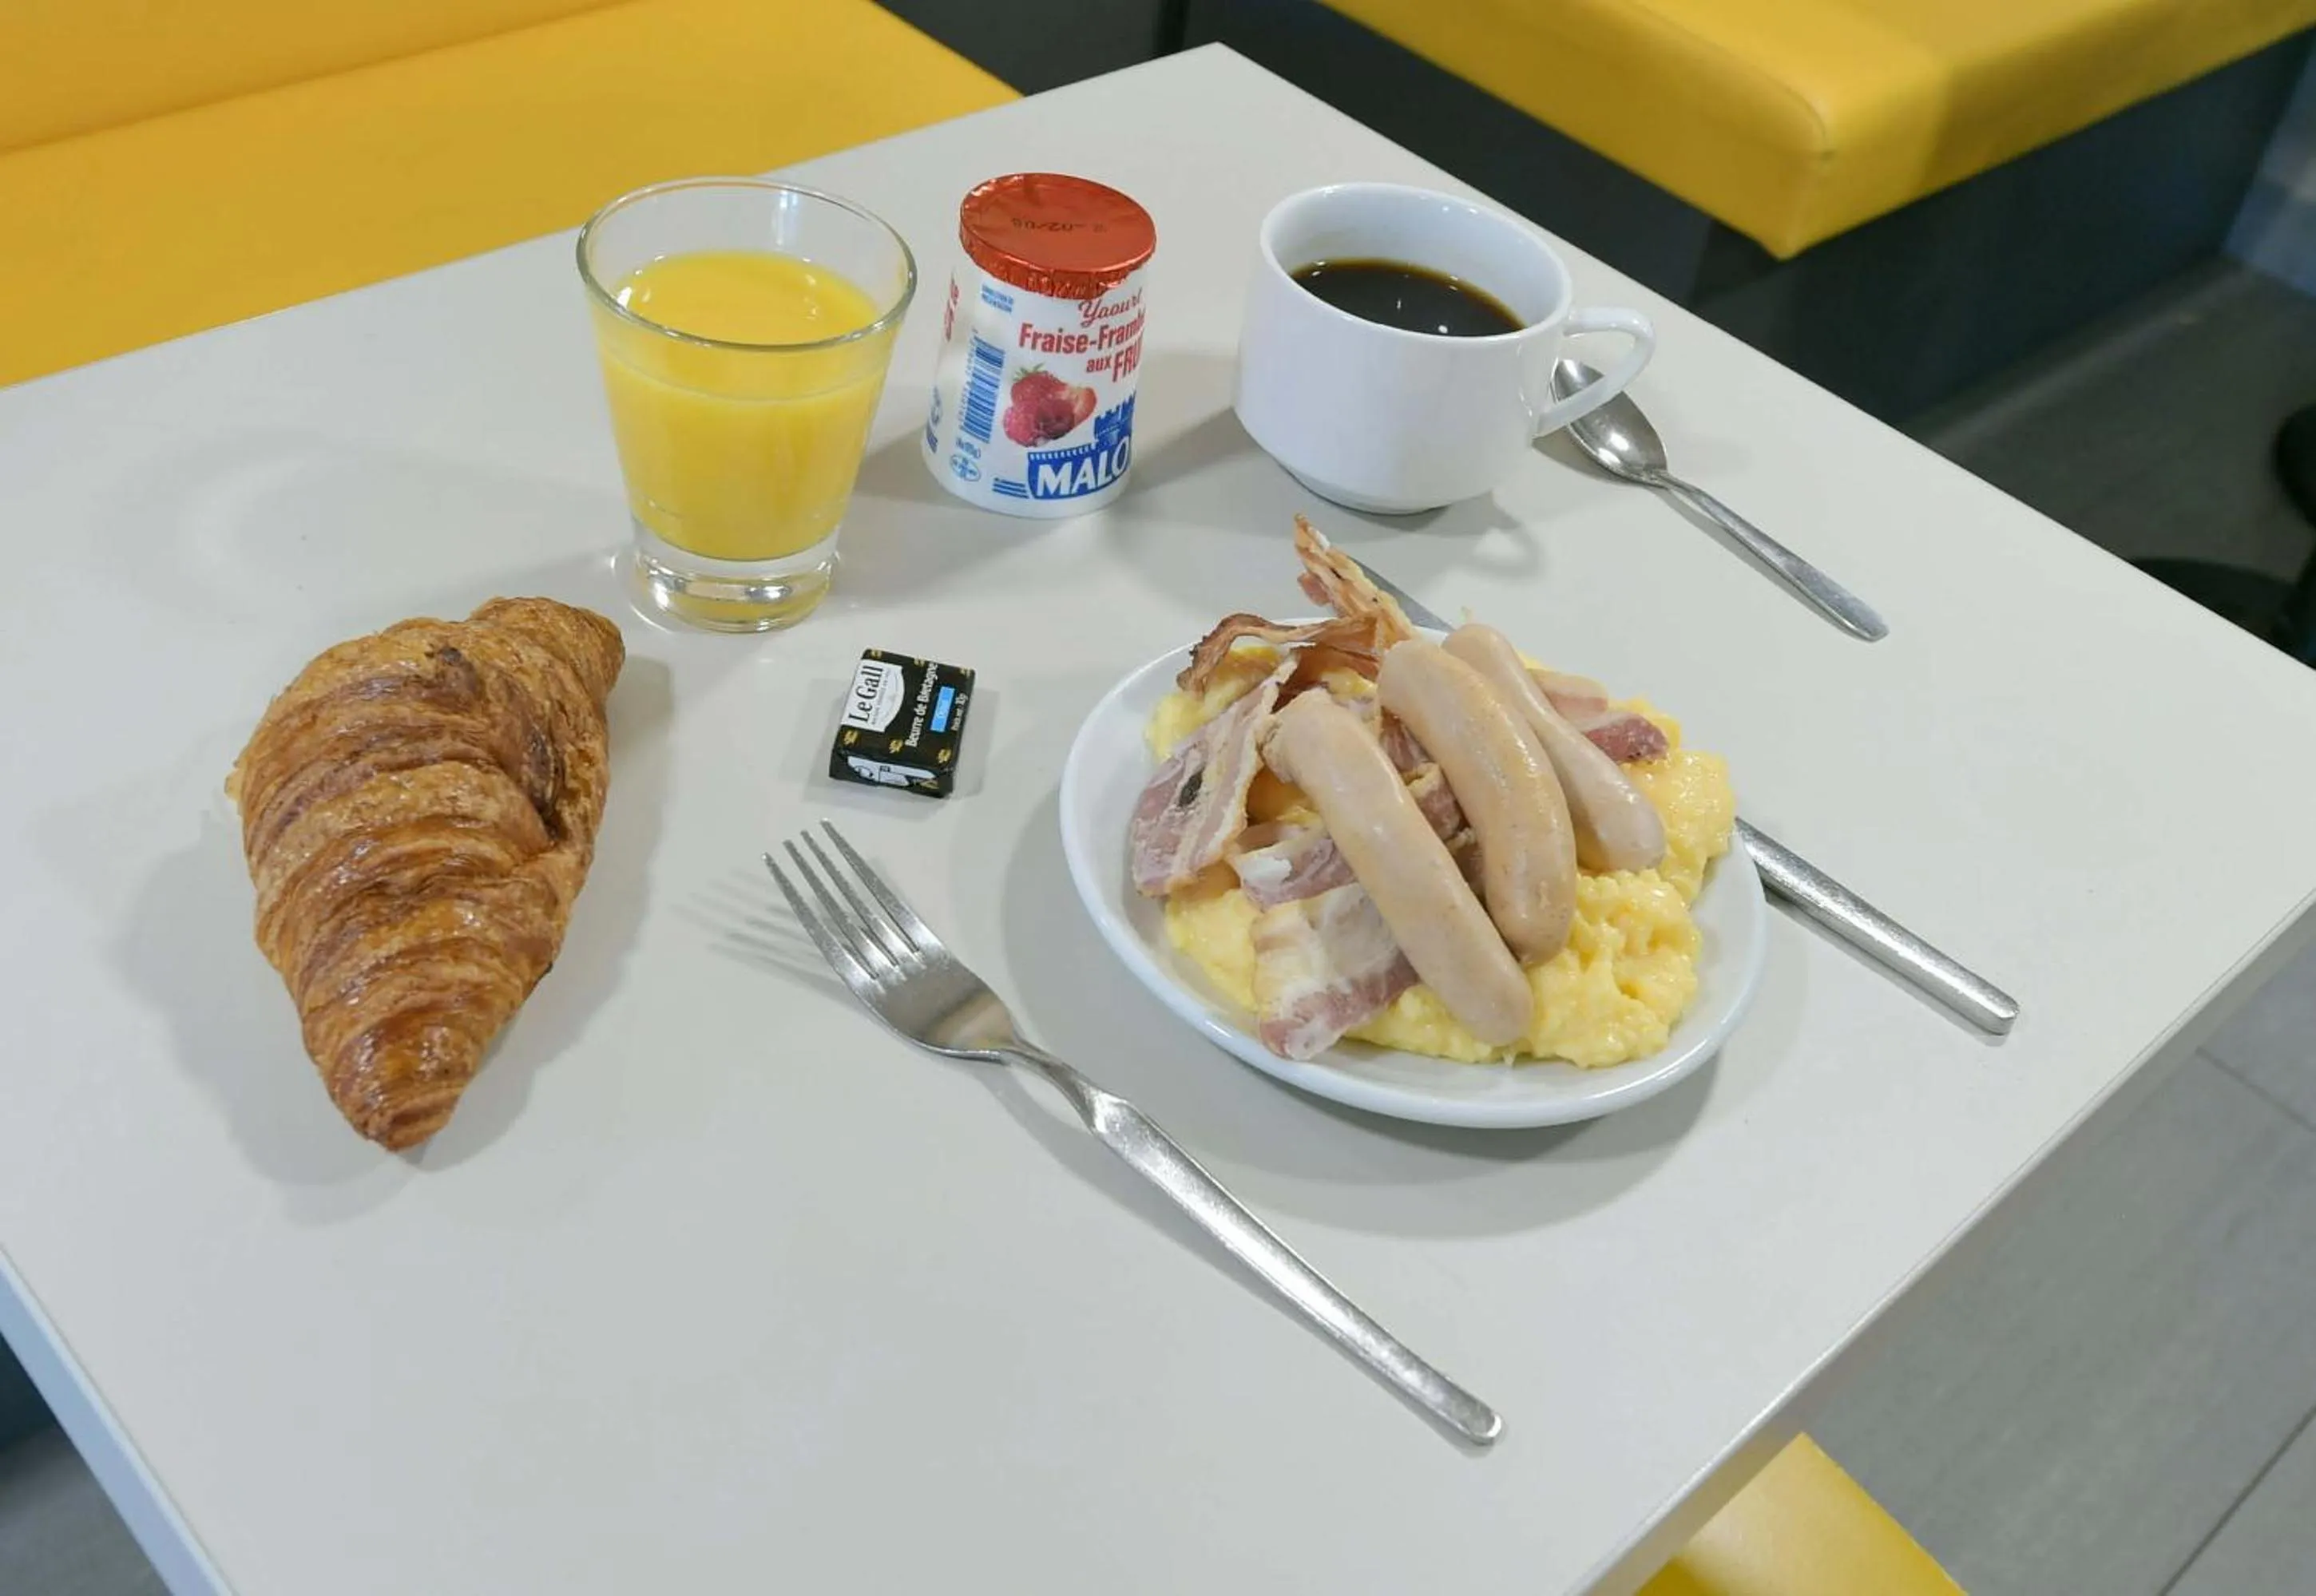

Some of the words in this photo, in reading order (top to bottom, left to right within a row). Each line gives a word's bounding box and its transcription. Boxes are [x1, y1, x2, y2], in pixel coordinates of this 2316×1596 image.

[1087, 354, 1112, 373] aux
[1038, 436, 1129, 497] MALO
[855, 665, 884, 700] Gall
[916, 663, 938, 703] Bretagne
[848, 701, 873, 723] Le
[914, 703, 927, 715] de
[904, 716, 924, 747] Beurre
